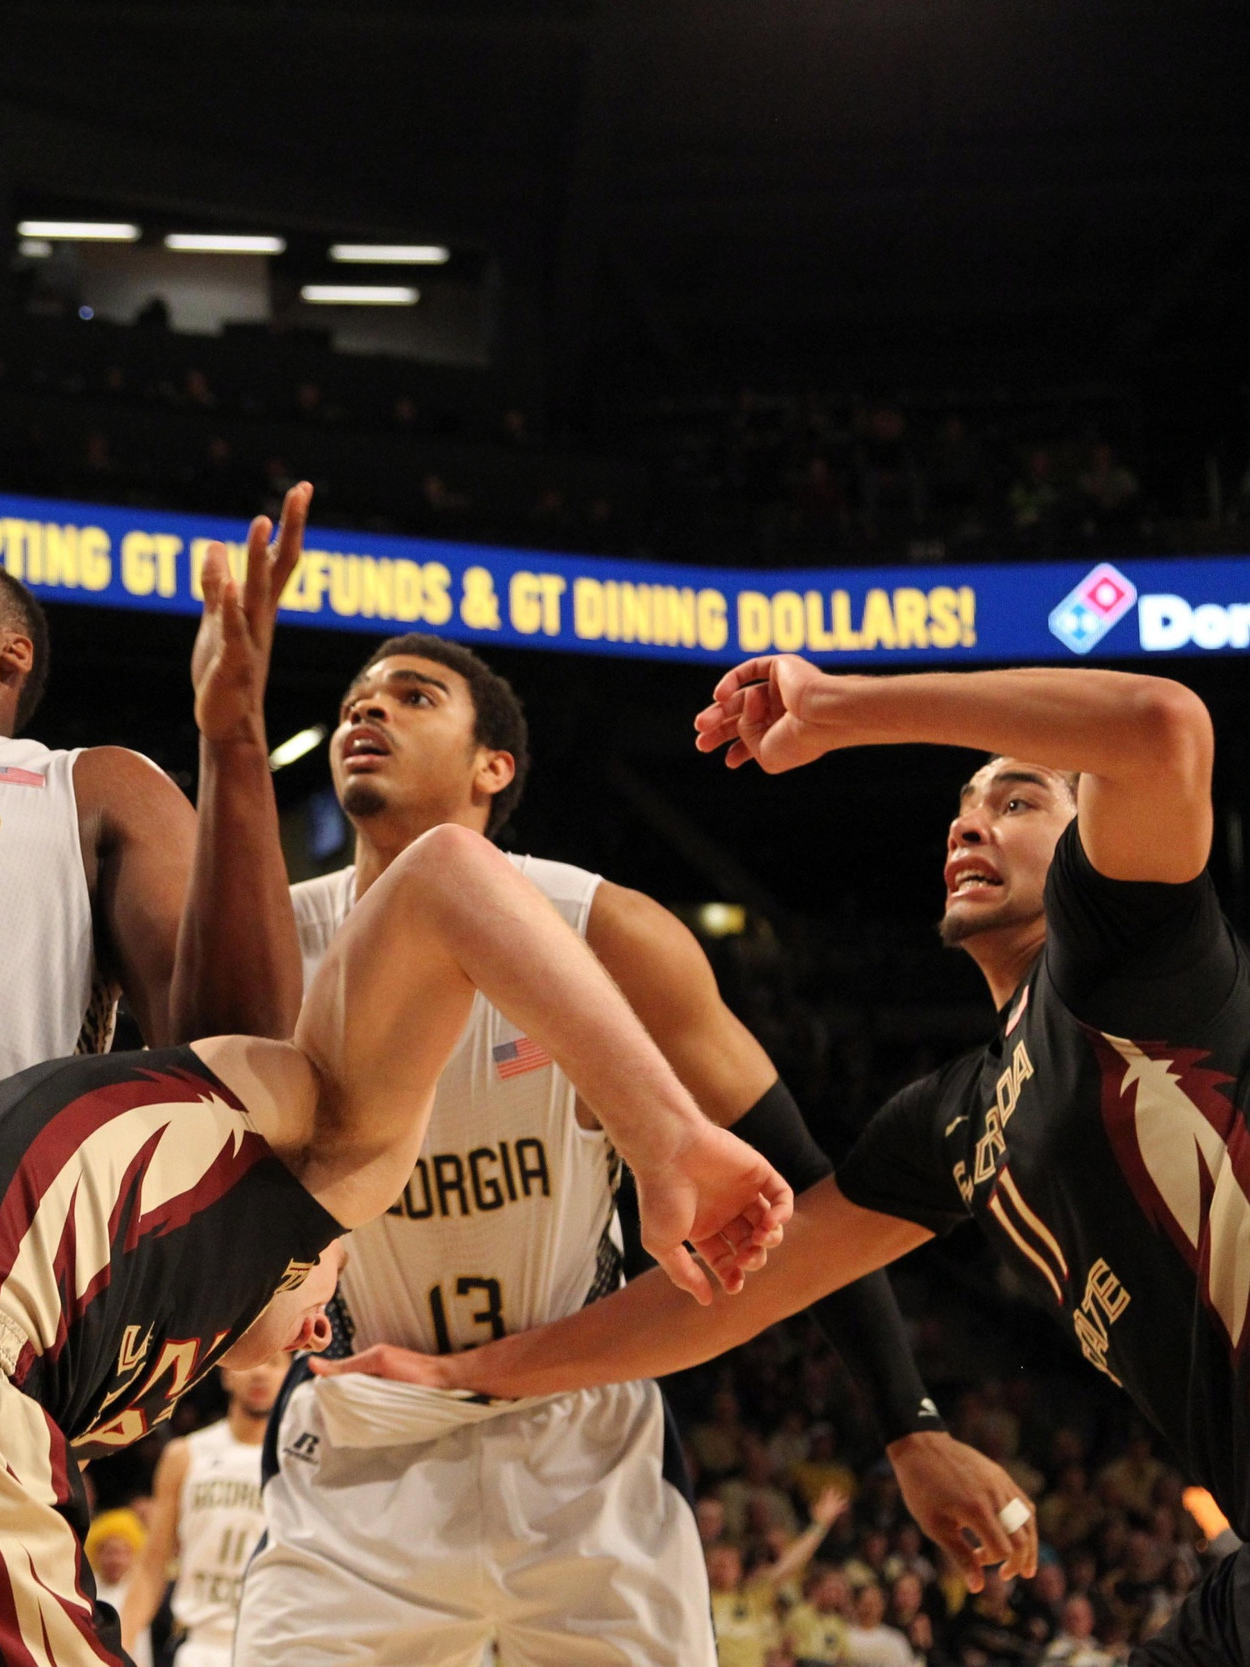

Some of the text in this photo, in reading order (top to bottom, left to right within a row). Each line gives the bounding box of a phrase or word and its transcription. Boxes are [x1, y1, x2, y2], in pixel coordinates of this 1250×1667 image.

[121, 531, 183, 598] GT
[460, 566, 501, 631] &
[509, 570, 566, 636] GT
[573, 577, 728, 651] DINING
[737, 585, 976, 653] DOLLARS!
[428, 1276, 507, 1355] 13
